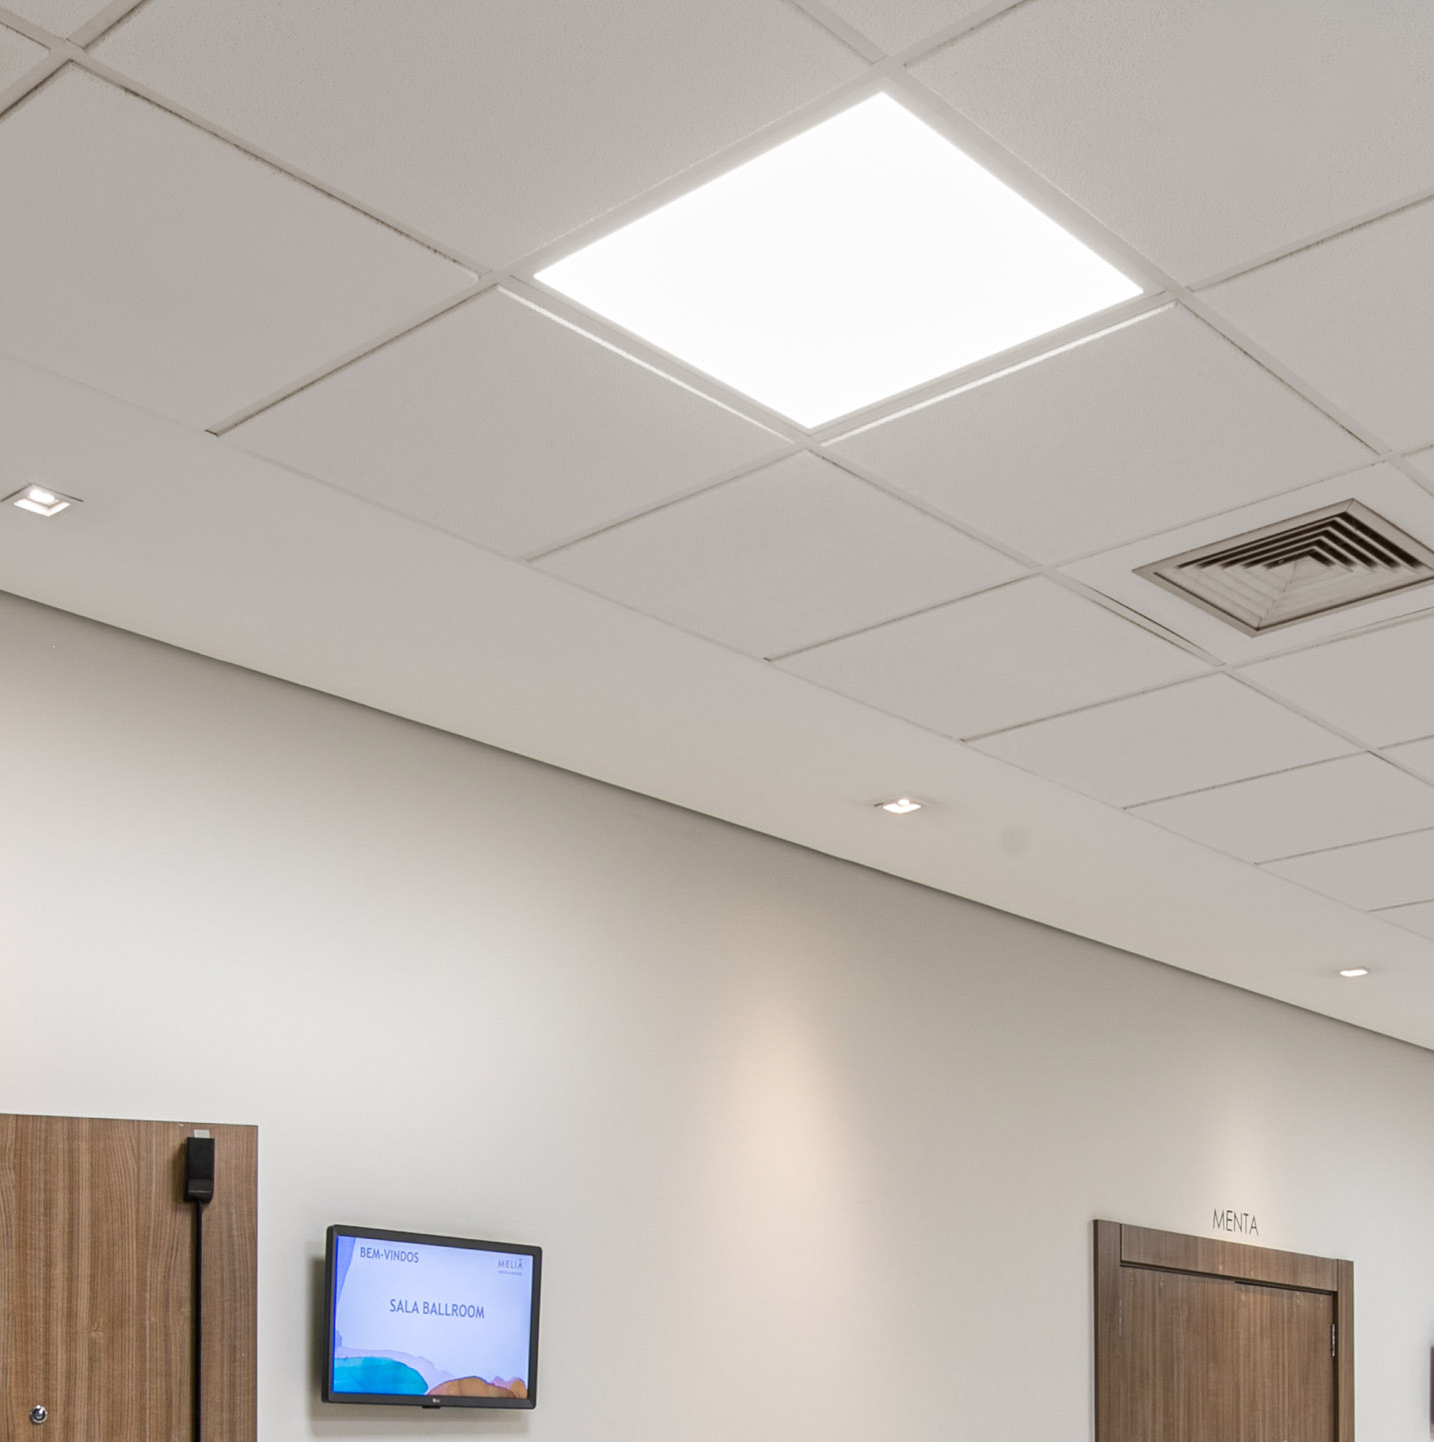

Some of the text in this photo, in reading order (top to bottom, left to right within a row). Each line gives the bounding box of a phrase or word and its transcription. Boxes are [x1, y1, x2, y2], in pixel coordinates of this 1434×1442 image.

[1212, 1208, 1259, 1237] MENTA
[360, 1246, 419, 1263] BEM-VINDOS
[390, 1299, 485, 1319] SALA BALLROOM
